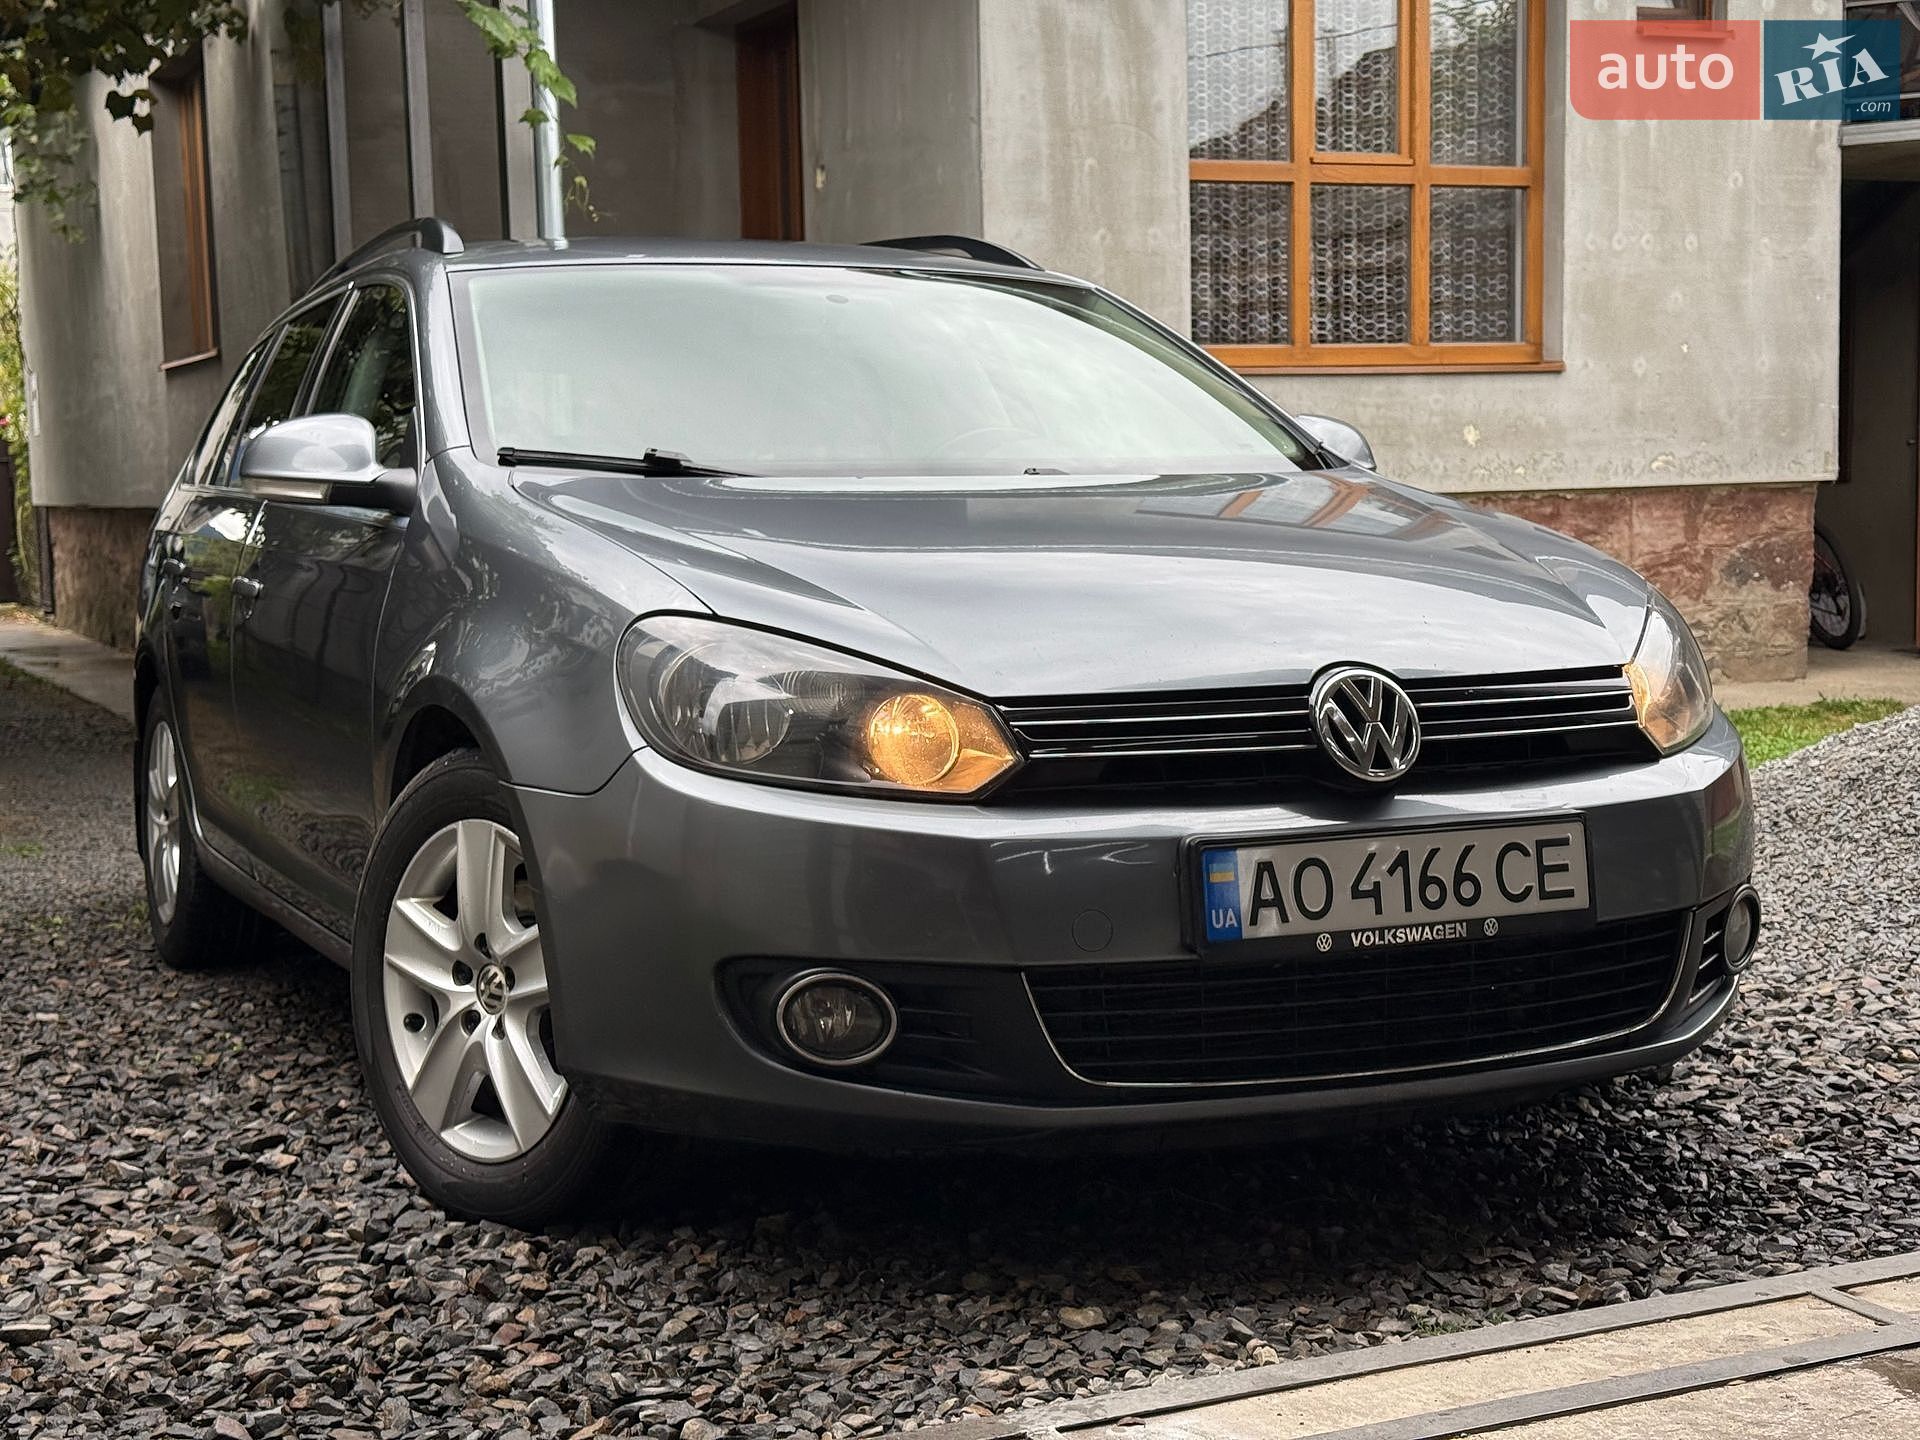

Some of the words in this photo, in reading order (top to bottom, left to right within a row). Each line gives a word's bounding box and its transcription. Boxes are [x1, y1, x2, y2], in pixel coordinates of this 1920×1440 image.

[1249, 856, 1334, 927] AO
[1351, 844, 1482, 916] 4166
[1495, 836, 1575, 904] CE
[1211, 908, 1238, 929] UA
[1350, 921, 1467, 948] VOLKSWAGEN
